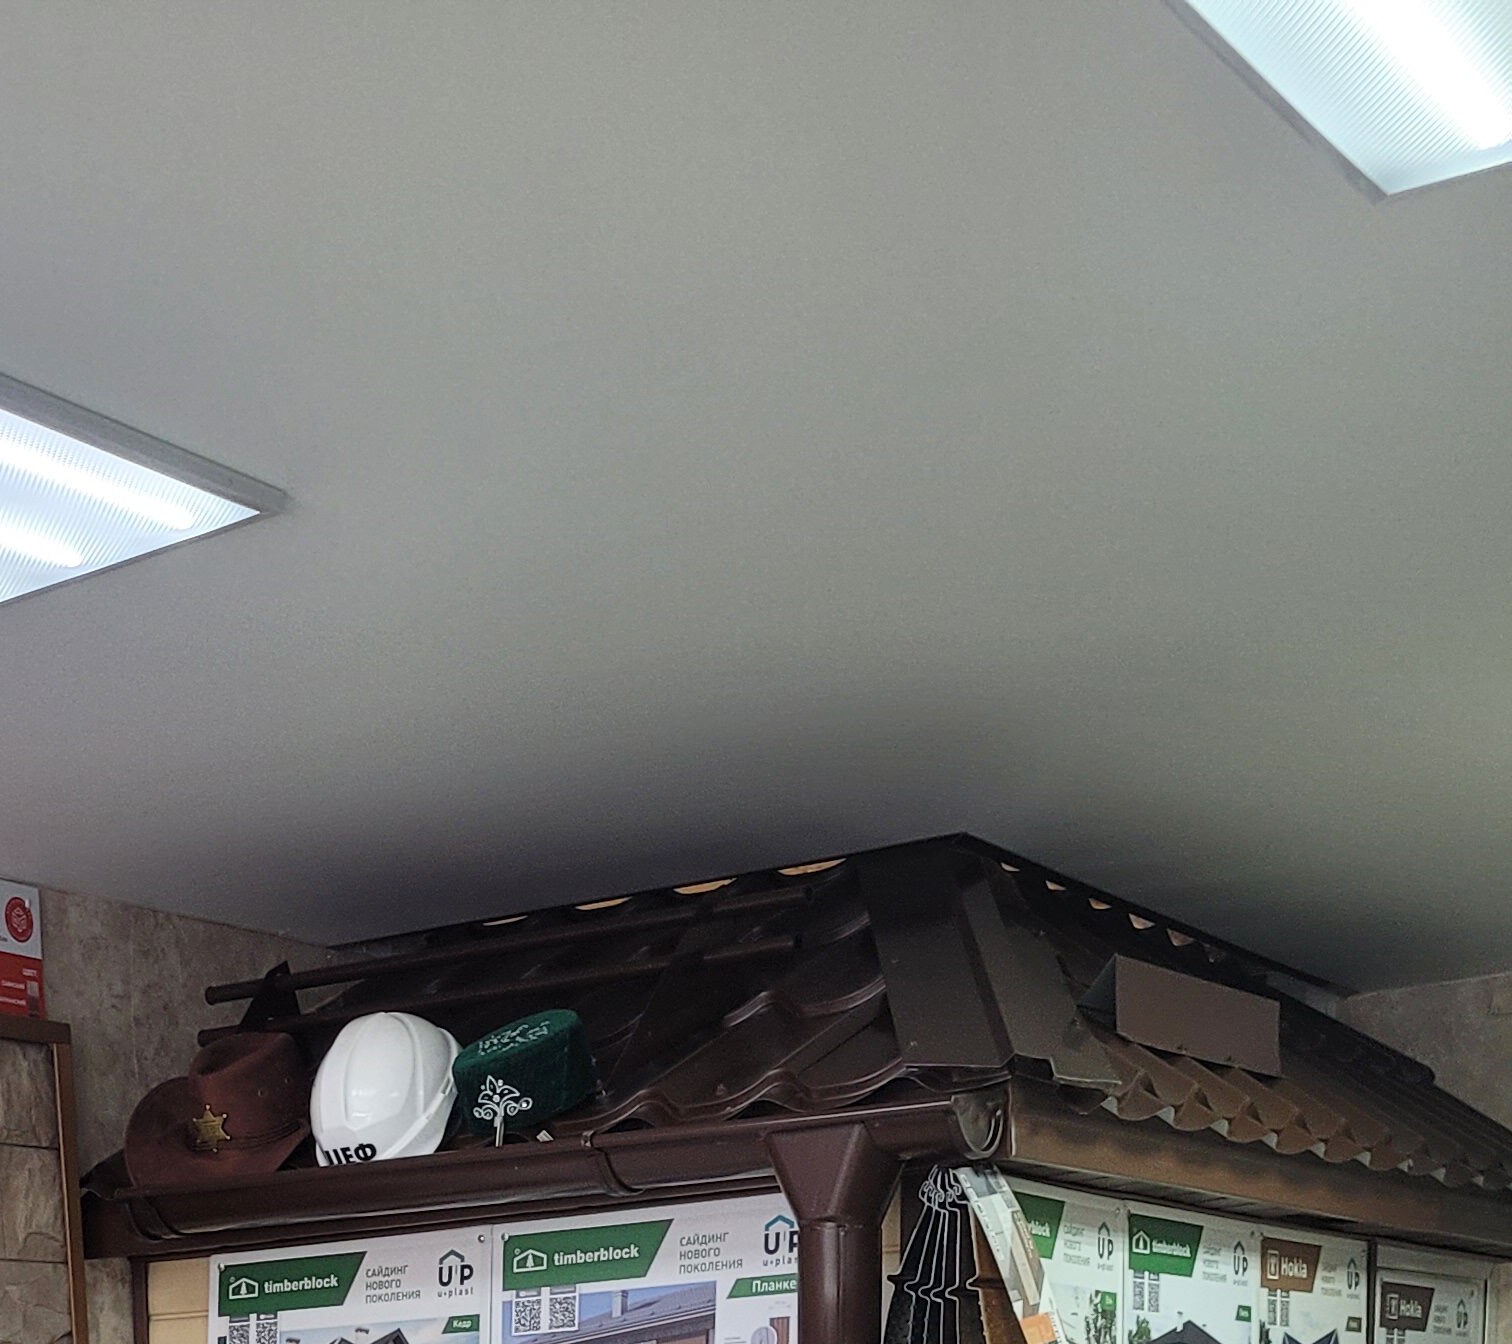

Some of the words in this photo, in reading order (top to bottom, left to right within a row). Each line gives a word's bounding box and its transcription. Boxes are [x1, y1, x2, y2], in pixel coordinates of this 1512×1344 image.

[679, 1232, 729, 1247] САЙДИНГ
[553, 1244, 639, 1266] timberblock
[679, 1247, 721, 1261] НОВОГО
[365, 1264, 409, 1278] САЙДИНГ
[679, 1258, 744, 1275] ПОКОЛЕНИЯ
[1280, 1256, 1308, 1279] Hokla
[264, 1274, 338, 1294] timberblock
[365, 1279, 402, 1291] НОВОГО
[365, 1289, 421, 1304] ПОКОЛЕНИЯ
[1399, 1299, 1422, 1318] Hokla
